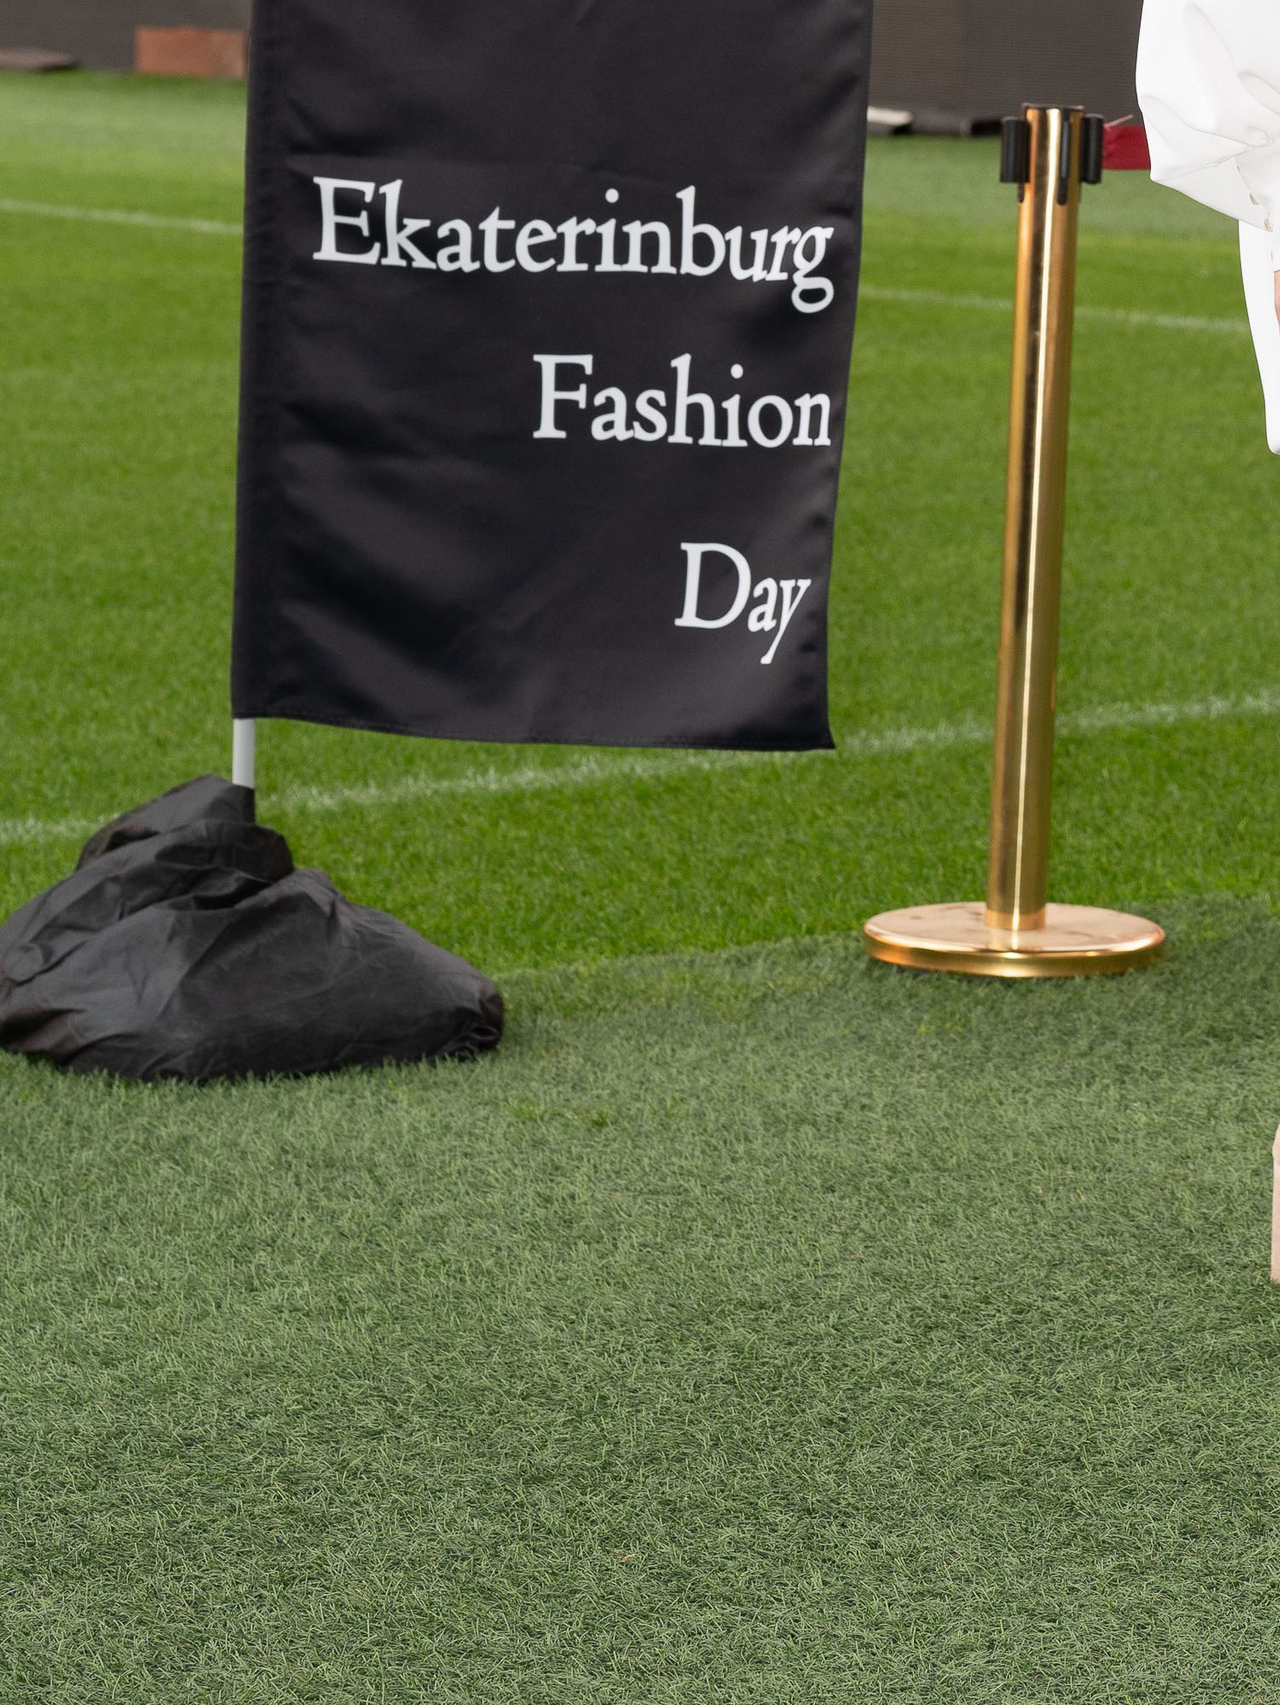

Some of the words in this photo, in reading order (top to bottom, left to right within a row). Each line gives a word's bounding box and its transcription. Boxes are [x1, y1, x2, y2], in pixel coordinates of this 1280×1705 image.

[312, 176, 835, 314] Ekaterinburg
[532, 352, 832, 448] Fashion
[674, 542, 812, 665] Day
